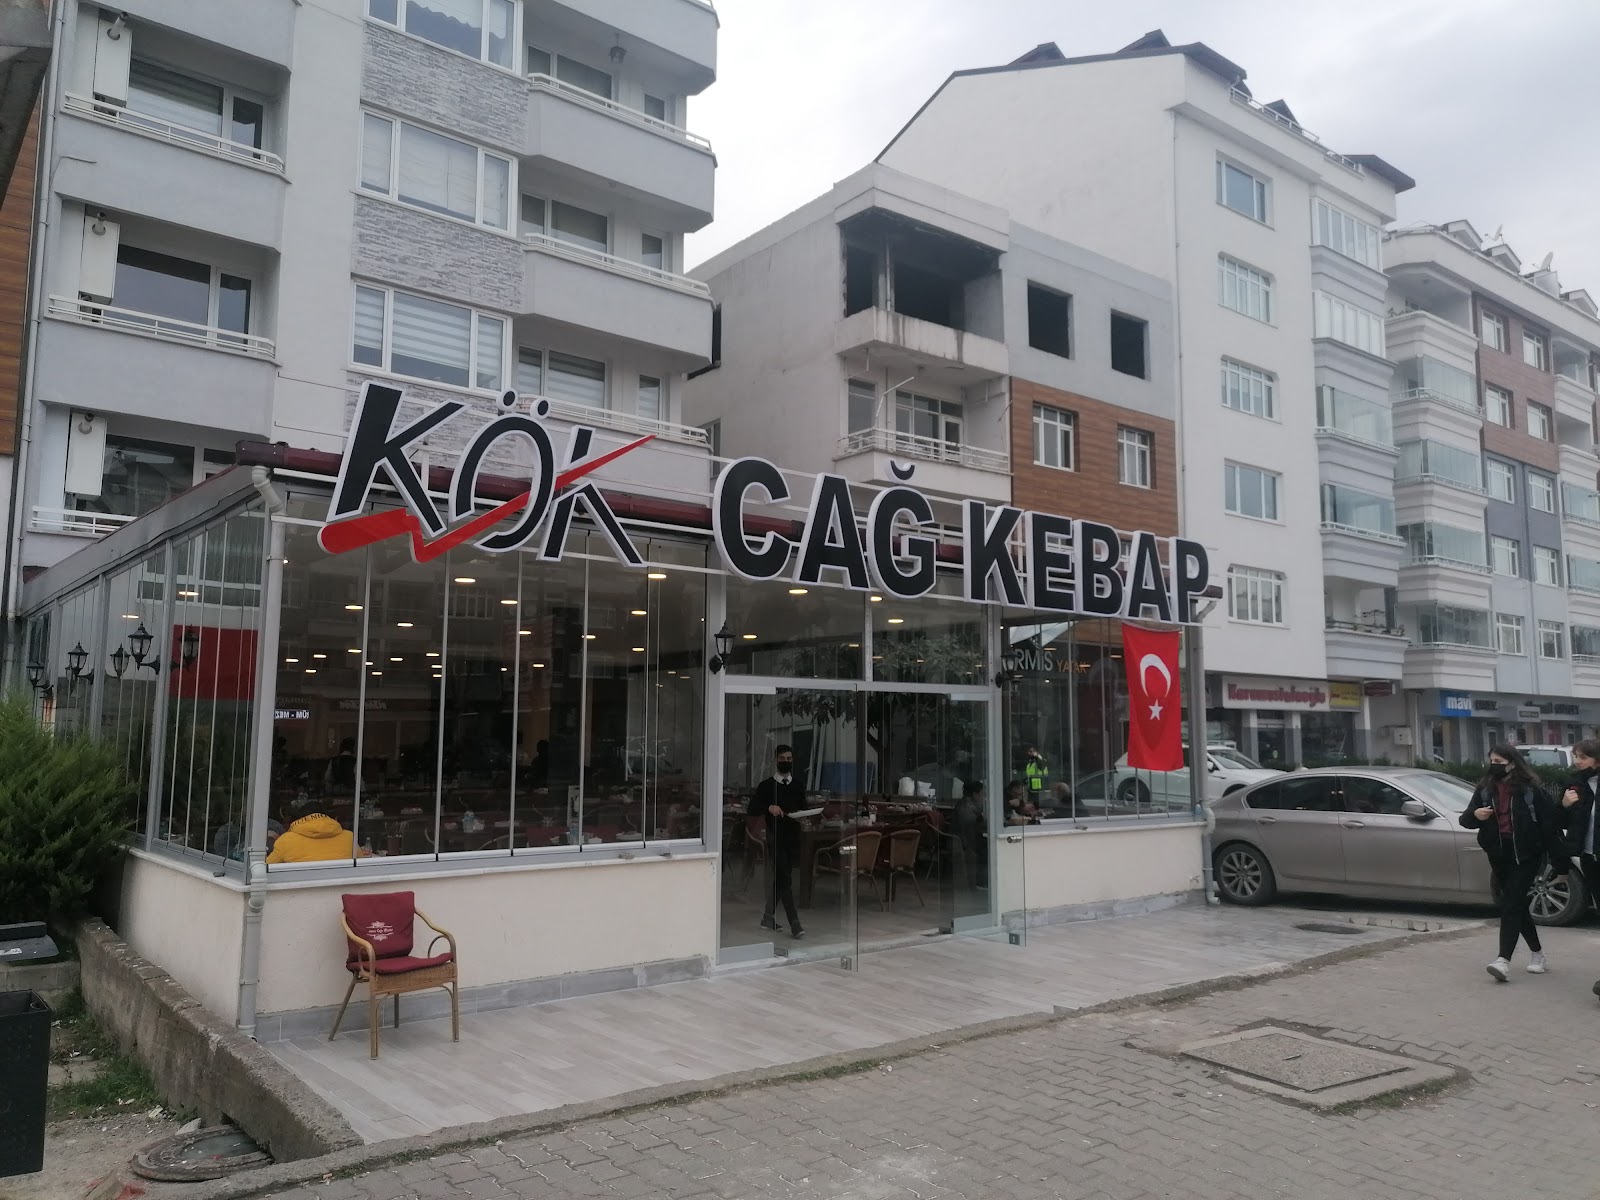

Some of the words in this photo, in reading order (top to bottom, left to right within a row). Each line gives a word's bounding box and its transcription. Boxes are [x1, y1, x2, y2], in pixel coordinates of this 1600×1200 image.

[330, 380, 648, 566] KÖK
[712, 456, 937, 599] CAĞ
[962, 499, 1209, 624] KEBAP
[1446, 694, 1472, 710] mavi
